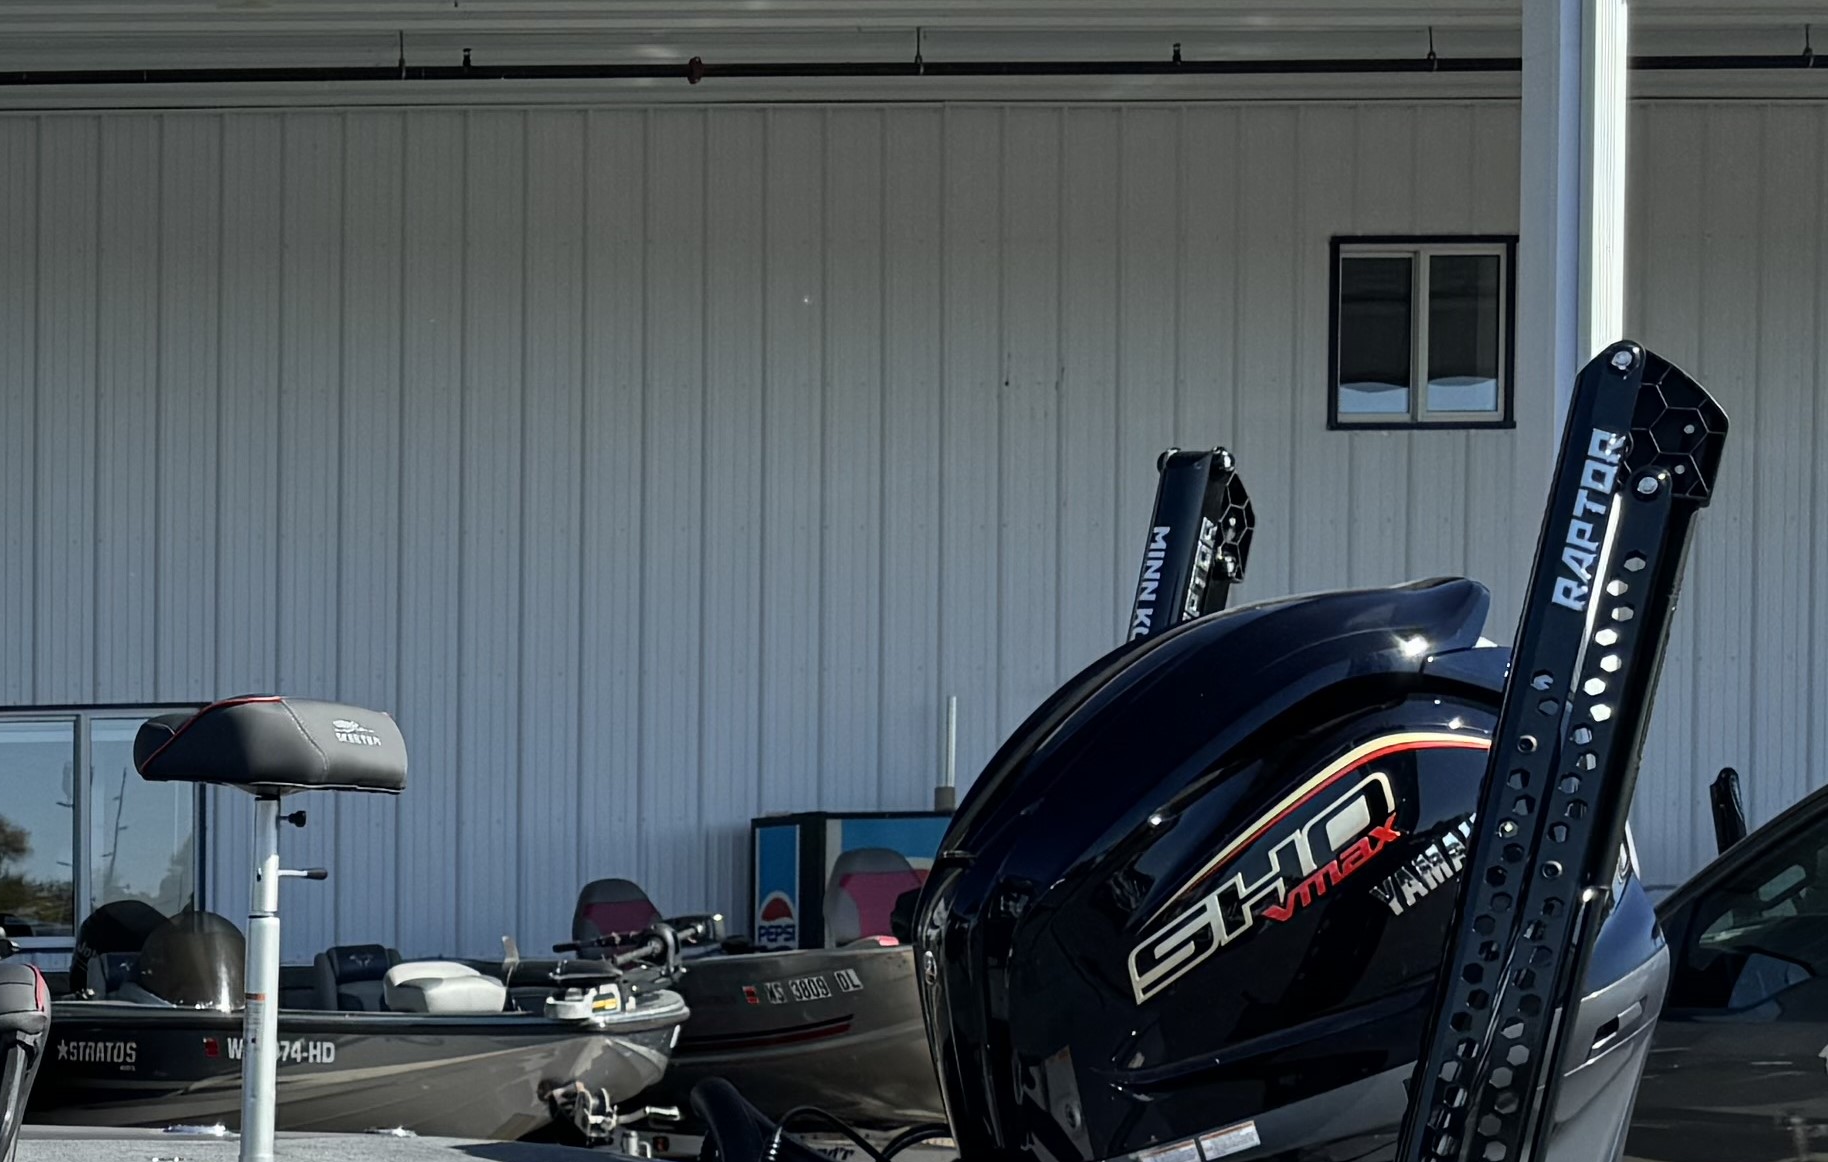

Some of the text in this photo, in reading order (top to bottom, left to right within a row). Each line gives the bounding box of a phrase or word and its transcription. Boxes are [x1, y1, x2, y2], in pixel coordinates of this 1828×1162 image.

[1551, 428, 1626, 611] RAPTOR
[1139, 526, 1170, 601] MINN
[1128, 771, 1395, 1005] SHO
[758, 924, 796, 942] PEPSI
[69, 1041, 137, 1063] STRATOS
